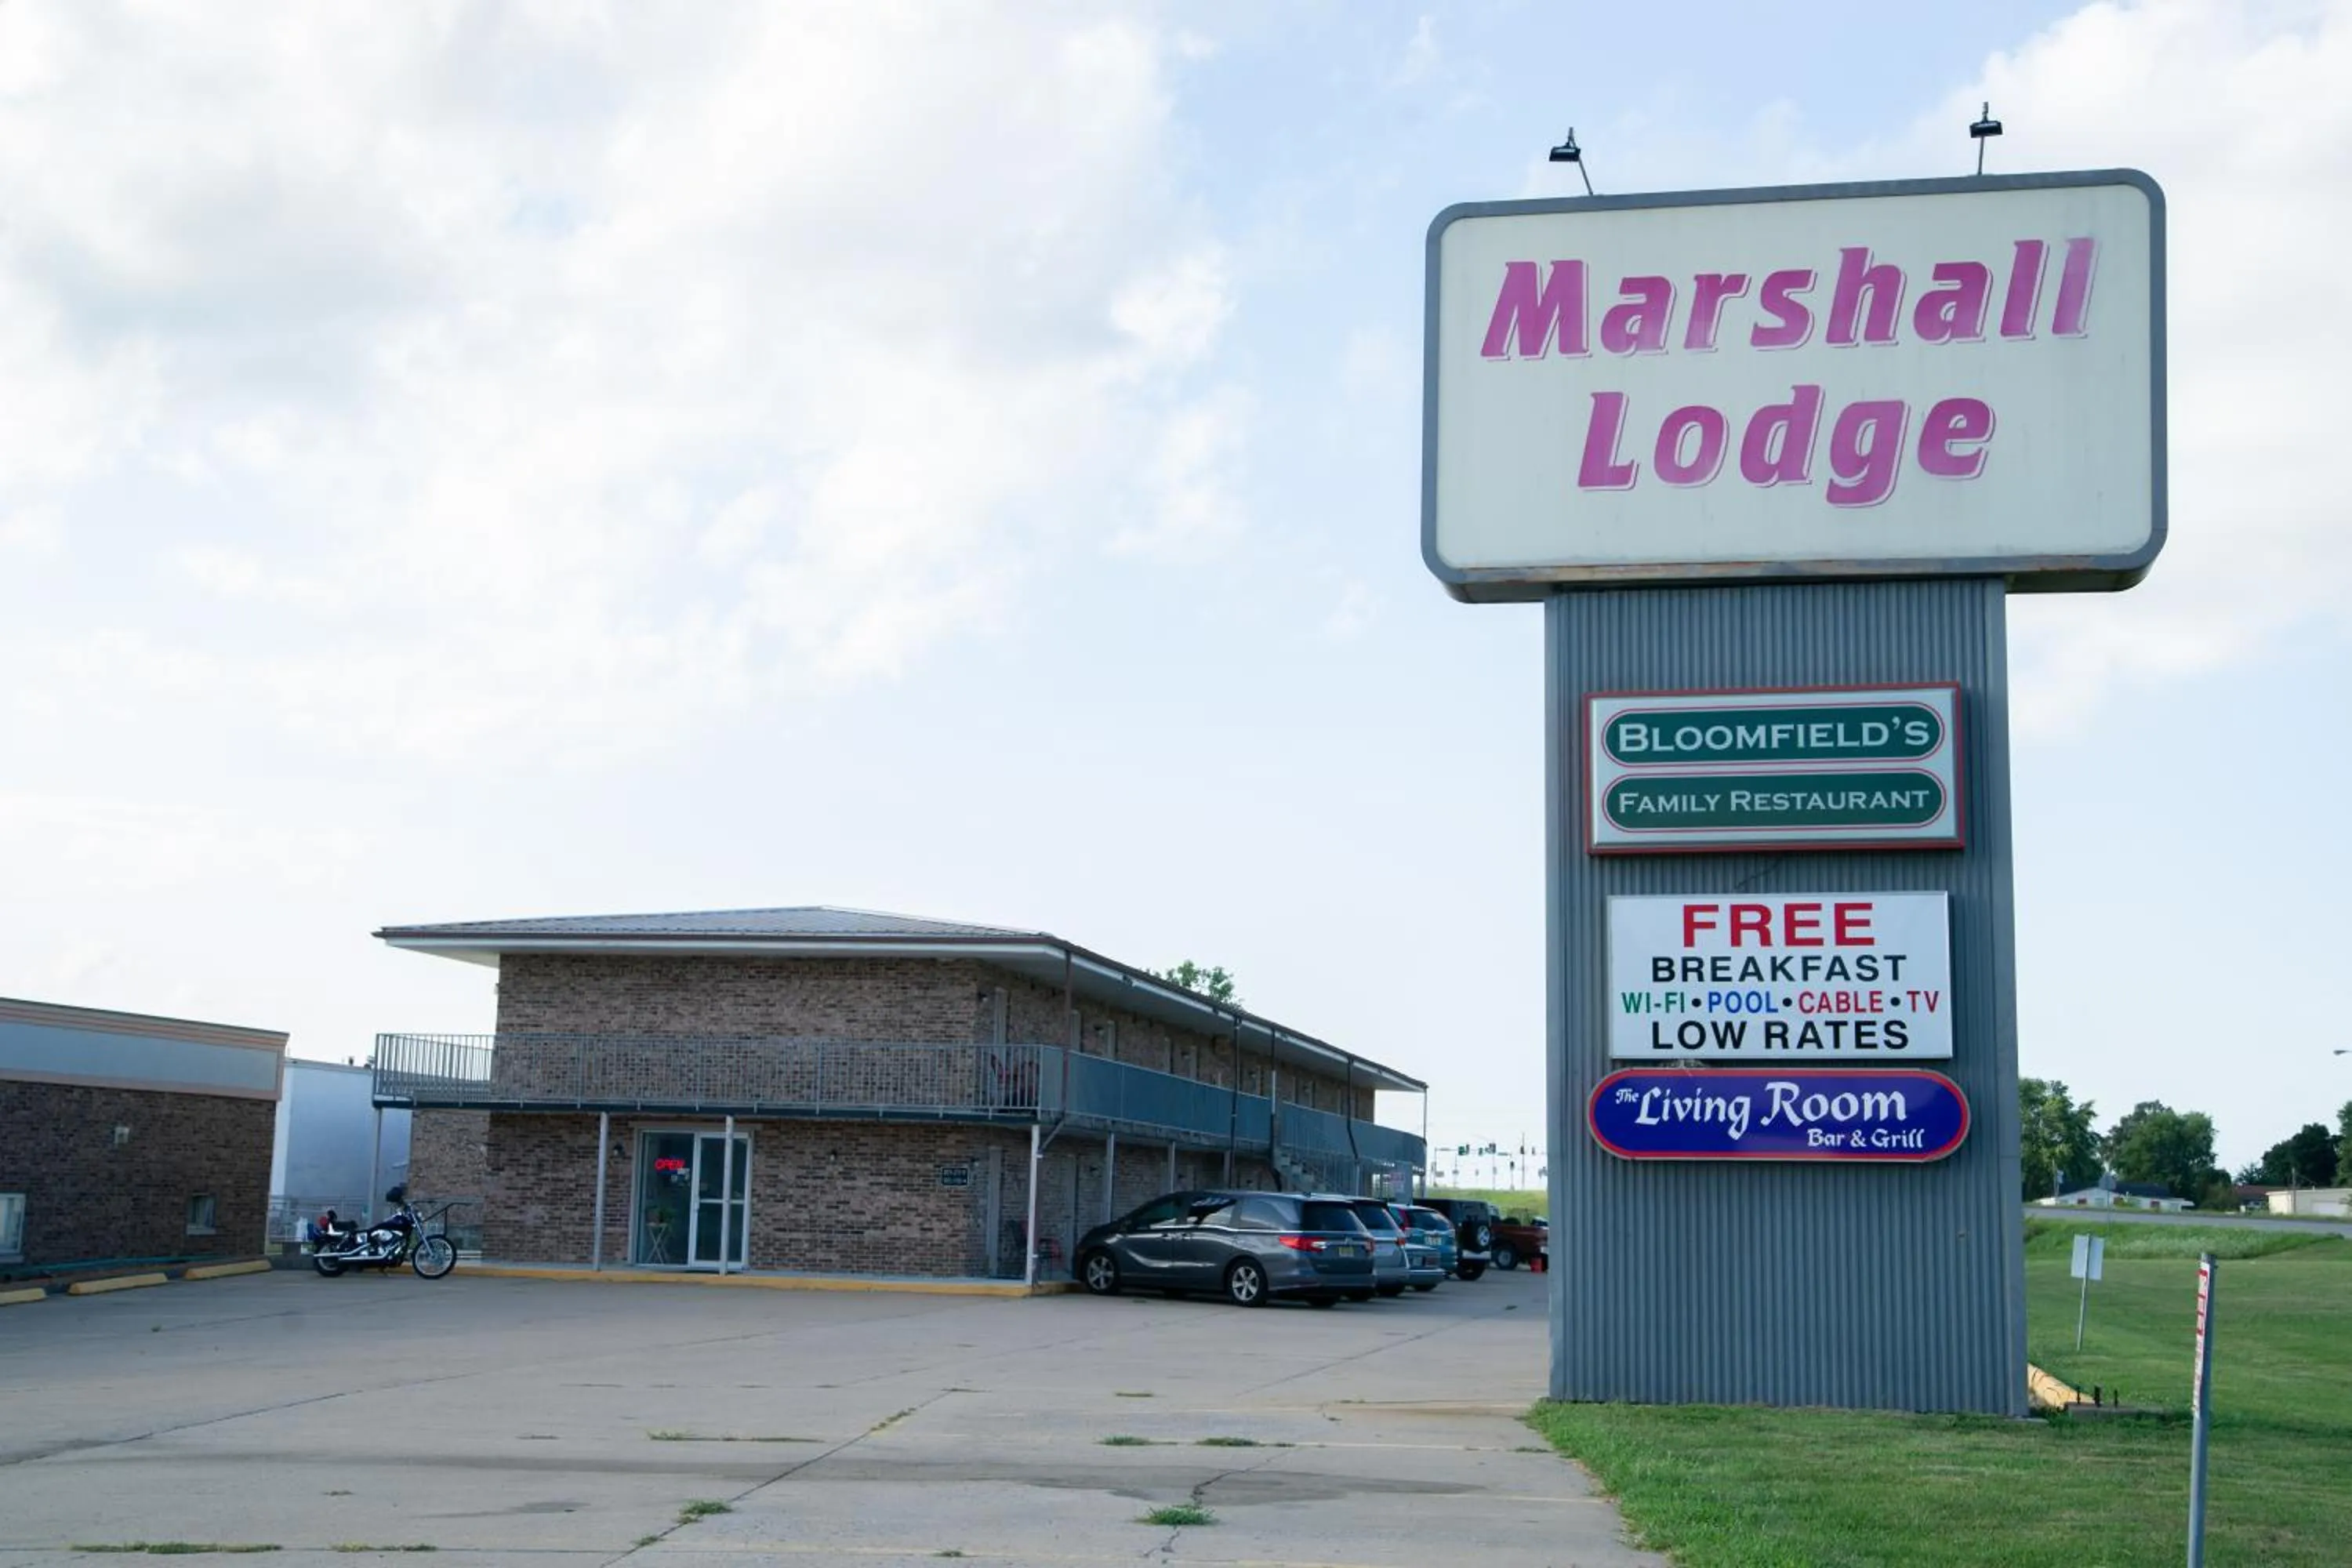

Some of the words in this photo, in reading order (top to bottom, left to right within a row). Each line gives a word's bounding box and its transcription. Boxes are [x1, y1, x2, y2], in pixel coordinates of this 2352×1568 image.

[1480, 237, 2097, 360] Marshall
[1577, 384, 1997, 509] Lodge
[1618, 716, 1930, 753] BLOOMFIELD'S
[1618, 792, 1721, 814] FAMILY
[1730, 789, 1929, 811] RESTAURANT
[1682, 902, 1875, 948] FREE
[1651, 954, 1907, 982] BREAKFAST
[1621, 992, 1686, 1014] WI-FI
[1708, 991, 1779, 1014] POOL
[1798, 991, 1883, 1014] CABLE
[1906, 990, 1940, 1013] TV
[1652, 1020, 1748, 1051] LOW
[1764, 1019, 1910, 1050] RATES
[1616, 1087, 1639, 1105] The
[1635, 1087, 1751, 1141] Living
[1760, 1080, 1907, 1127] Room
[1806, 1128, 1844, 1148] Bar
[1849, 1128, 1867, 1148] &
[1871, 1128, 1925, 1149] Grill
[655, 1158, 684, 1170] OPEN
